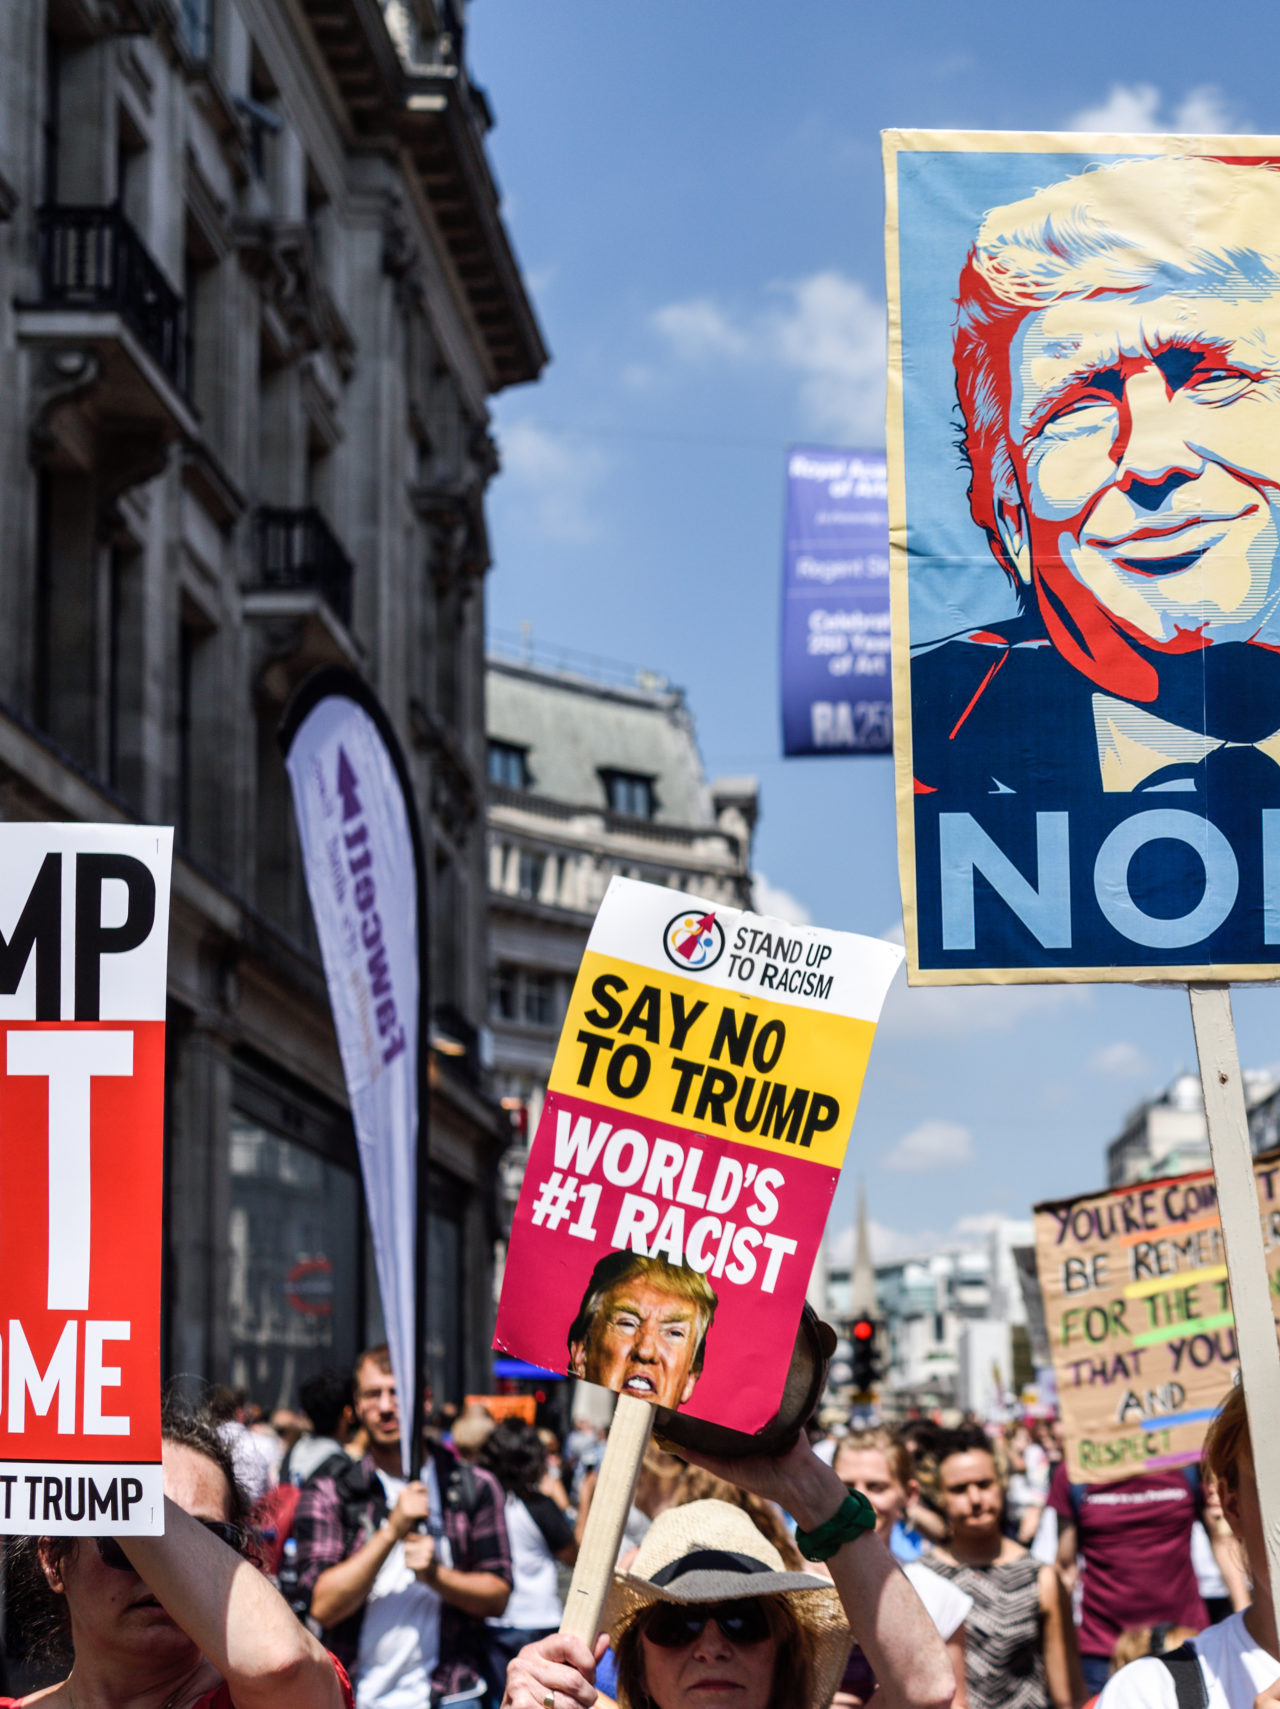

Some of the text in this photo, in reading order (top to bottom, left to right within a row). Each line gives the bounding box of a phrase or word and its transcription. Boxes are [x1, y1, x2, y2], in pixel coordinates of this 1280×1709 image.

[728, 954, 834, 1000] TO RACISM
[733, 926, 833, 968] STAND UP
[584, 973, 786, 1074] SAY NO
[576, 1029, 840, 1148] TO TRUMP
[553, 1109, 785, 1227] WORLD'S
[531, 1172, 798, 1294] #1 RACIST
[1061, 1253, 1111, 1295] BE
[1060, 1299, 1131, 1345] FOR
[1140, 1284, 1200, 1329] THE
[0, 1318, 131, 1436] ME
[1066, 1348, 1147, 1387] THAT
[1168, 1327, 1240, 1373] YOU
[1116, 1382, 1185, 1424] AND
[1078, 1427, 1175, 1470] RESPECT
[24, 1475, 144, 1522] TRUMP
